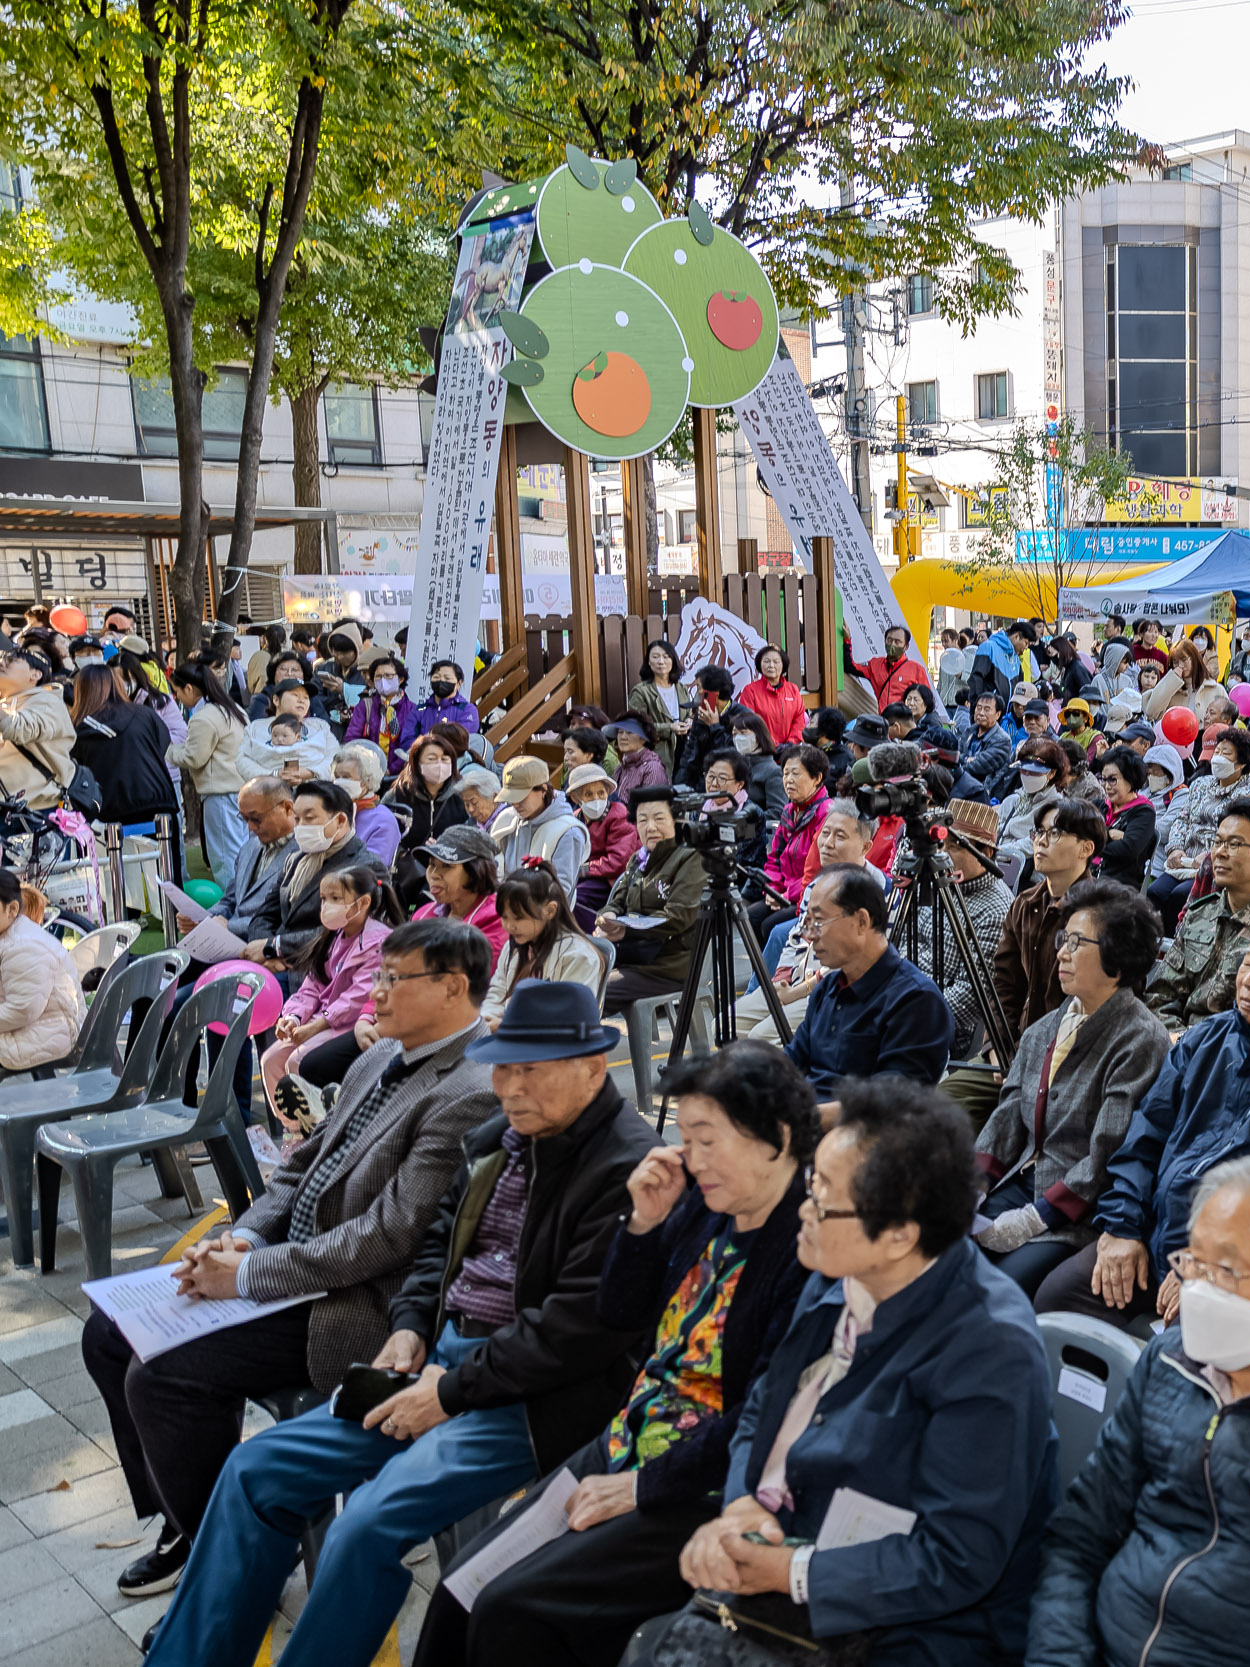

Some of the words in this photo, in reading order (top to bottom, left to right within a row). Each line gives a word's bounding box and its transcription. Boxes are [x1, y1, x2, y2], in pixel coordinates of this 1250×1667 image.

[449, 346, 461, 388] 난다고
[446, 393, 456, 421] 하여
[456, 498, 471, 556] 이곳에서
[470, 500, 486, 574] 유래
[757, 551, 792, 566] 당구장
[1084, 537, 1114, 555] 대림
[1117, 537, 1158, 547] 공인중개사
